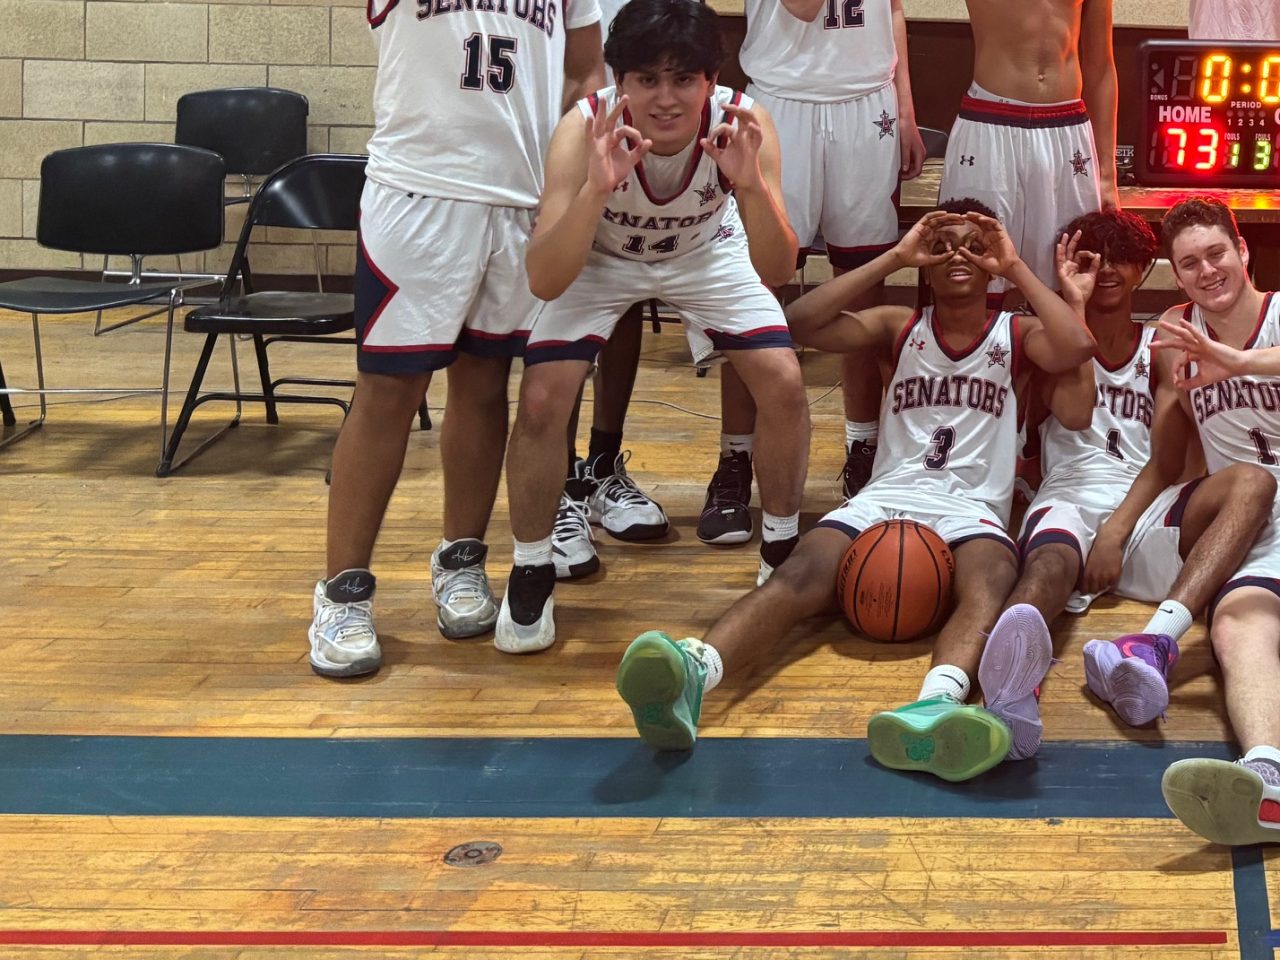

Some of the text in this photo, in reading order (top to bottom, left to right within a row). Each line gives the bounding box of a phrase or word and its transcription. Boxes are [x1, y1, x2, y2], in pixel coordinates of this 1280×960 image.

[459, 32, 518, 95] 15
[1158, 106, 1212, 123] HOME
[1230, 101, 1262, 109] PERIOD
[1259, 119, 1265, 127] 4
[1166, 128, 1219, 170] 73
[1224, 133, 1240, 141] FOULS
[1255, 133, 1271, 141] FOULS
[1253, 140, 1271, 170] 3
[622, 234, 680, 255] 14
[892, 374, 1008, 419] SENATORS
[923, 425, 956, 470] 3
[1247, 427, 1280, 467] 1
